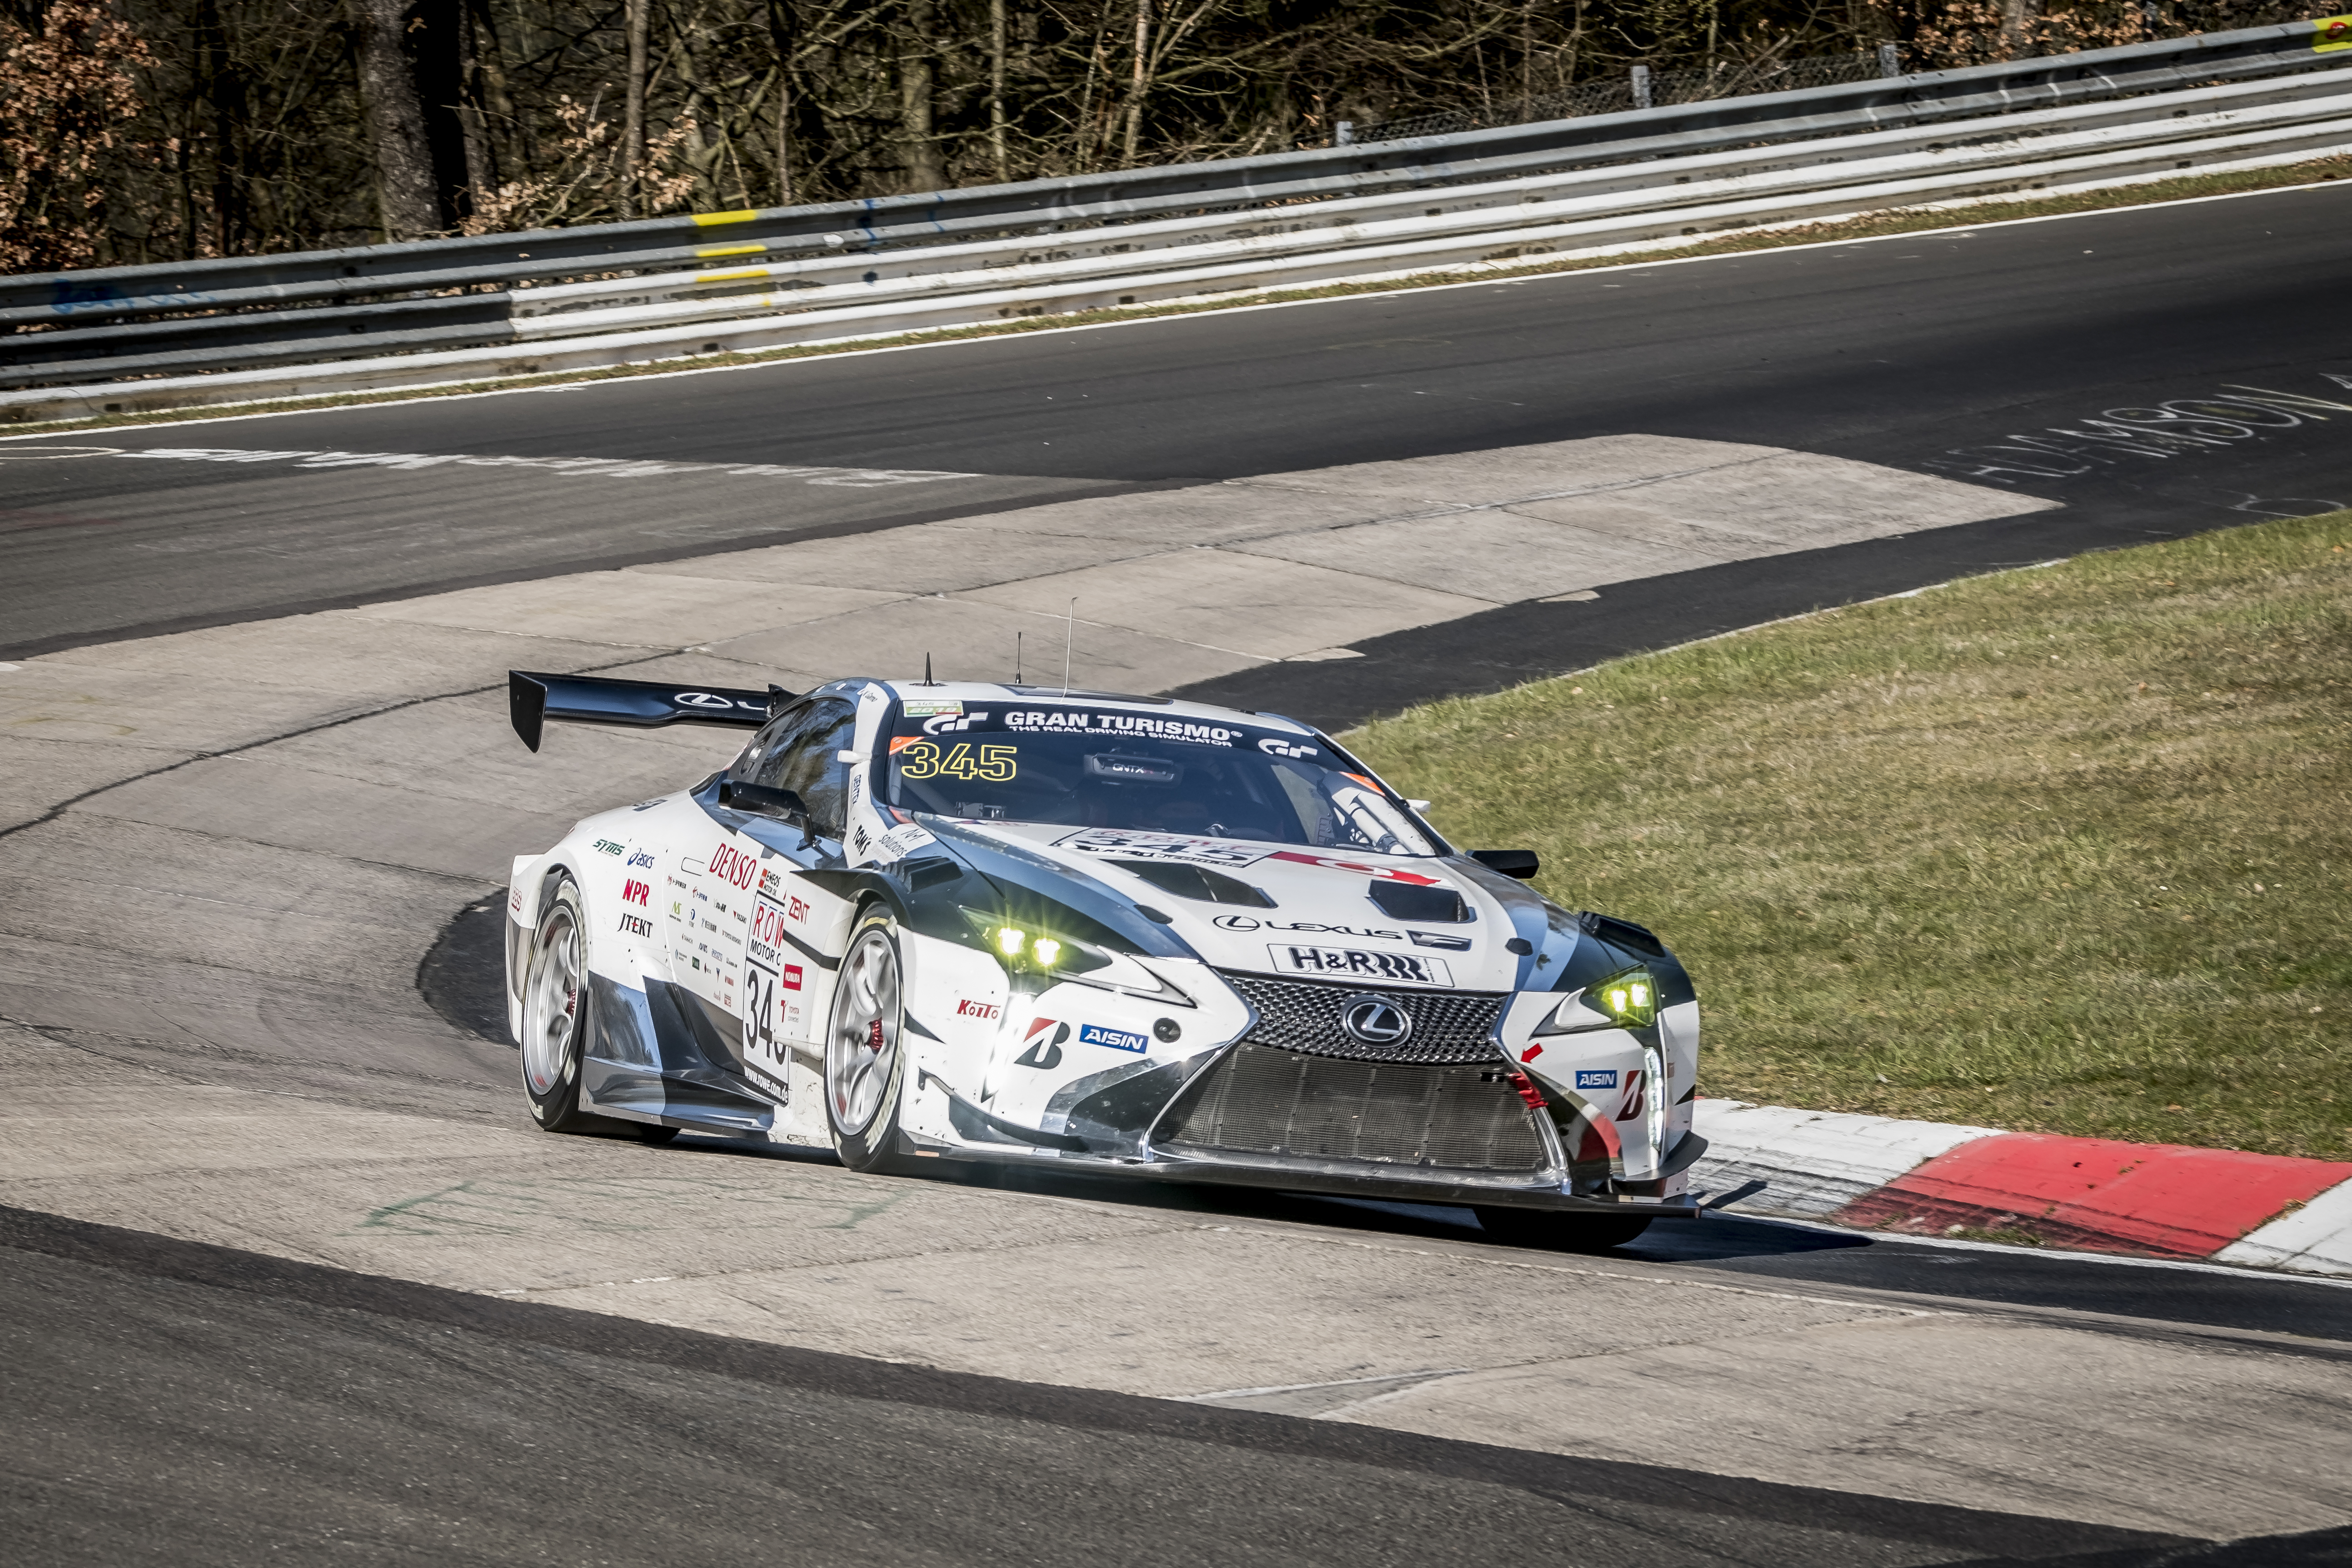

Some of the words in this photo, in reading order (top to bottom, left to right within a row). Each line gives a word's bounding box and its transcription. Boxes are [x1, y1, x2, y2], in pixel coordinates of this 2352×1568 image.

[1004, 712, 1089, 727] GRAN
[1084, 727, 1146, 737] DRIVING
[1148, 732, 1232, 747] SIMULATOR
[901, 742, 1017, 782] 345
[878, 833, 907, 858] solutions
[1075, 835, 1254, 861] 345
[709, 842, 757, 891] DENSO
[766, 871, 781, 888] ENEOS
[512, 886, 523, 913] BBS
[622, 878, 649, 907] NPR
[788, 895, 810, 925] ZENT
[617, 912, 653, 939] JTEKT
[1265, 919, 1403, 940] LEXUS
[750, 939, 775, 963] MOTOR
[1288, 946, 1381, 976] H&R
[746, 969, 787, 1065] 34
[1084, 1028, 1144, 1050] AISIN
[743, 1065, 788, 1104] www.rowe.com.de
[1579, 1074, 1615, 1086] AISIN
